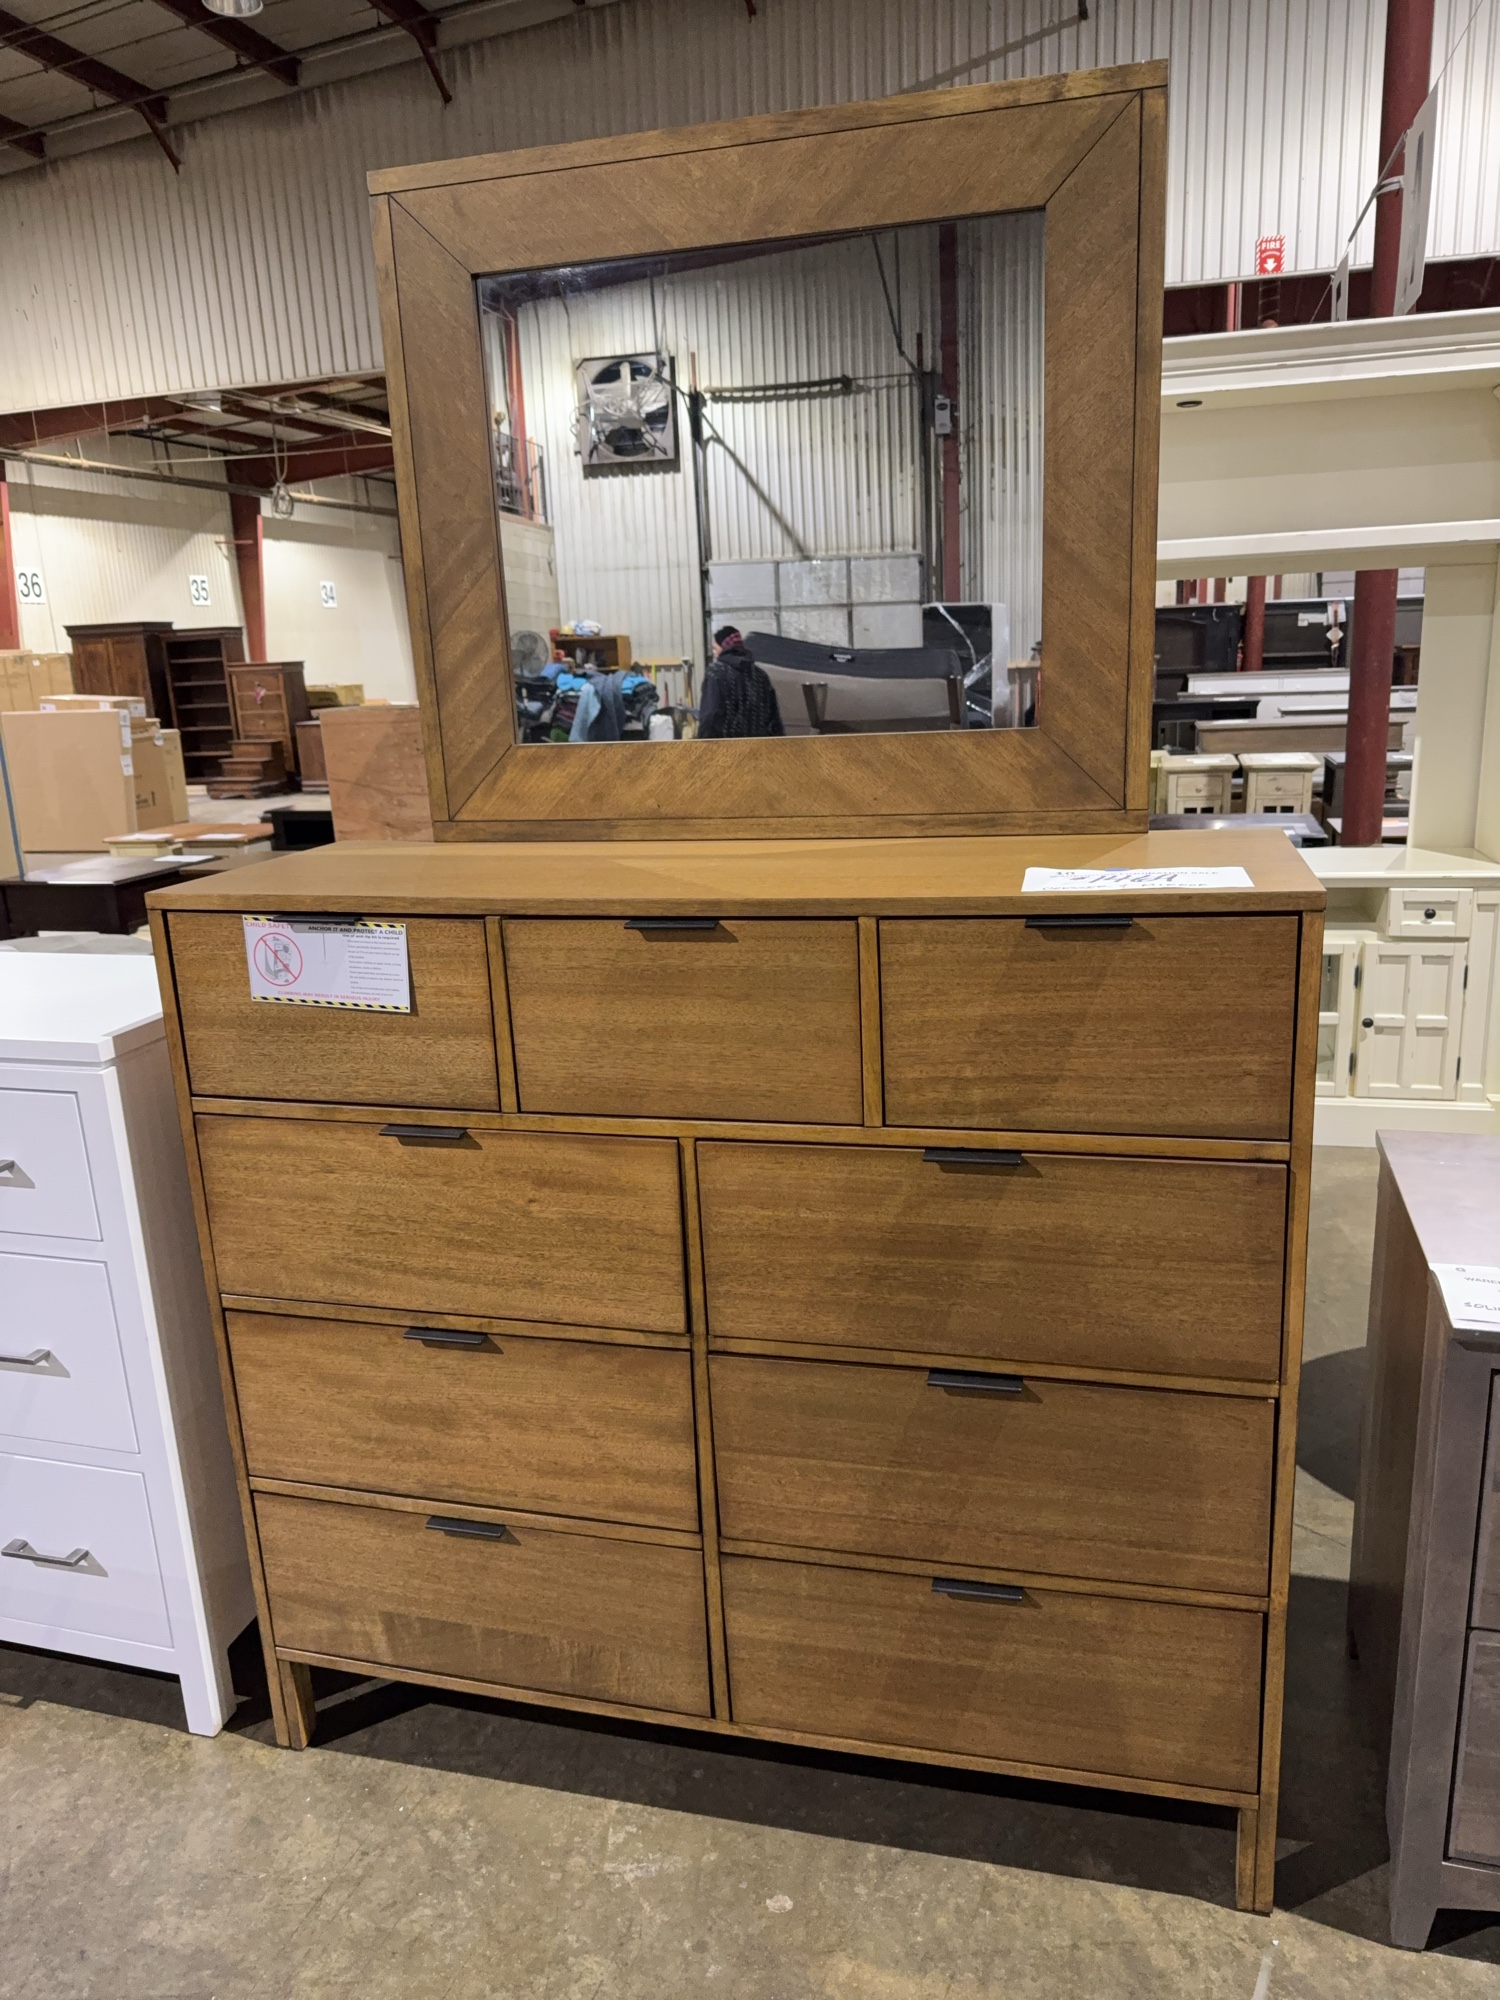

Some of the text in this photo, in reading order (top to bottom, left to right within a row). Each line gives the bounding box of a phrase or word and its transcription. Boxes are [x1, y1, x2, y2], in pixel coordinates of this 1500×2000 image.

[1261, 240, 1281, 250] FIRE
[18, 572, 43, 598] 36
[191, 579, 209, 601] 35
[321, 584, 336, 604] 34
